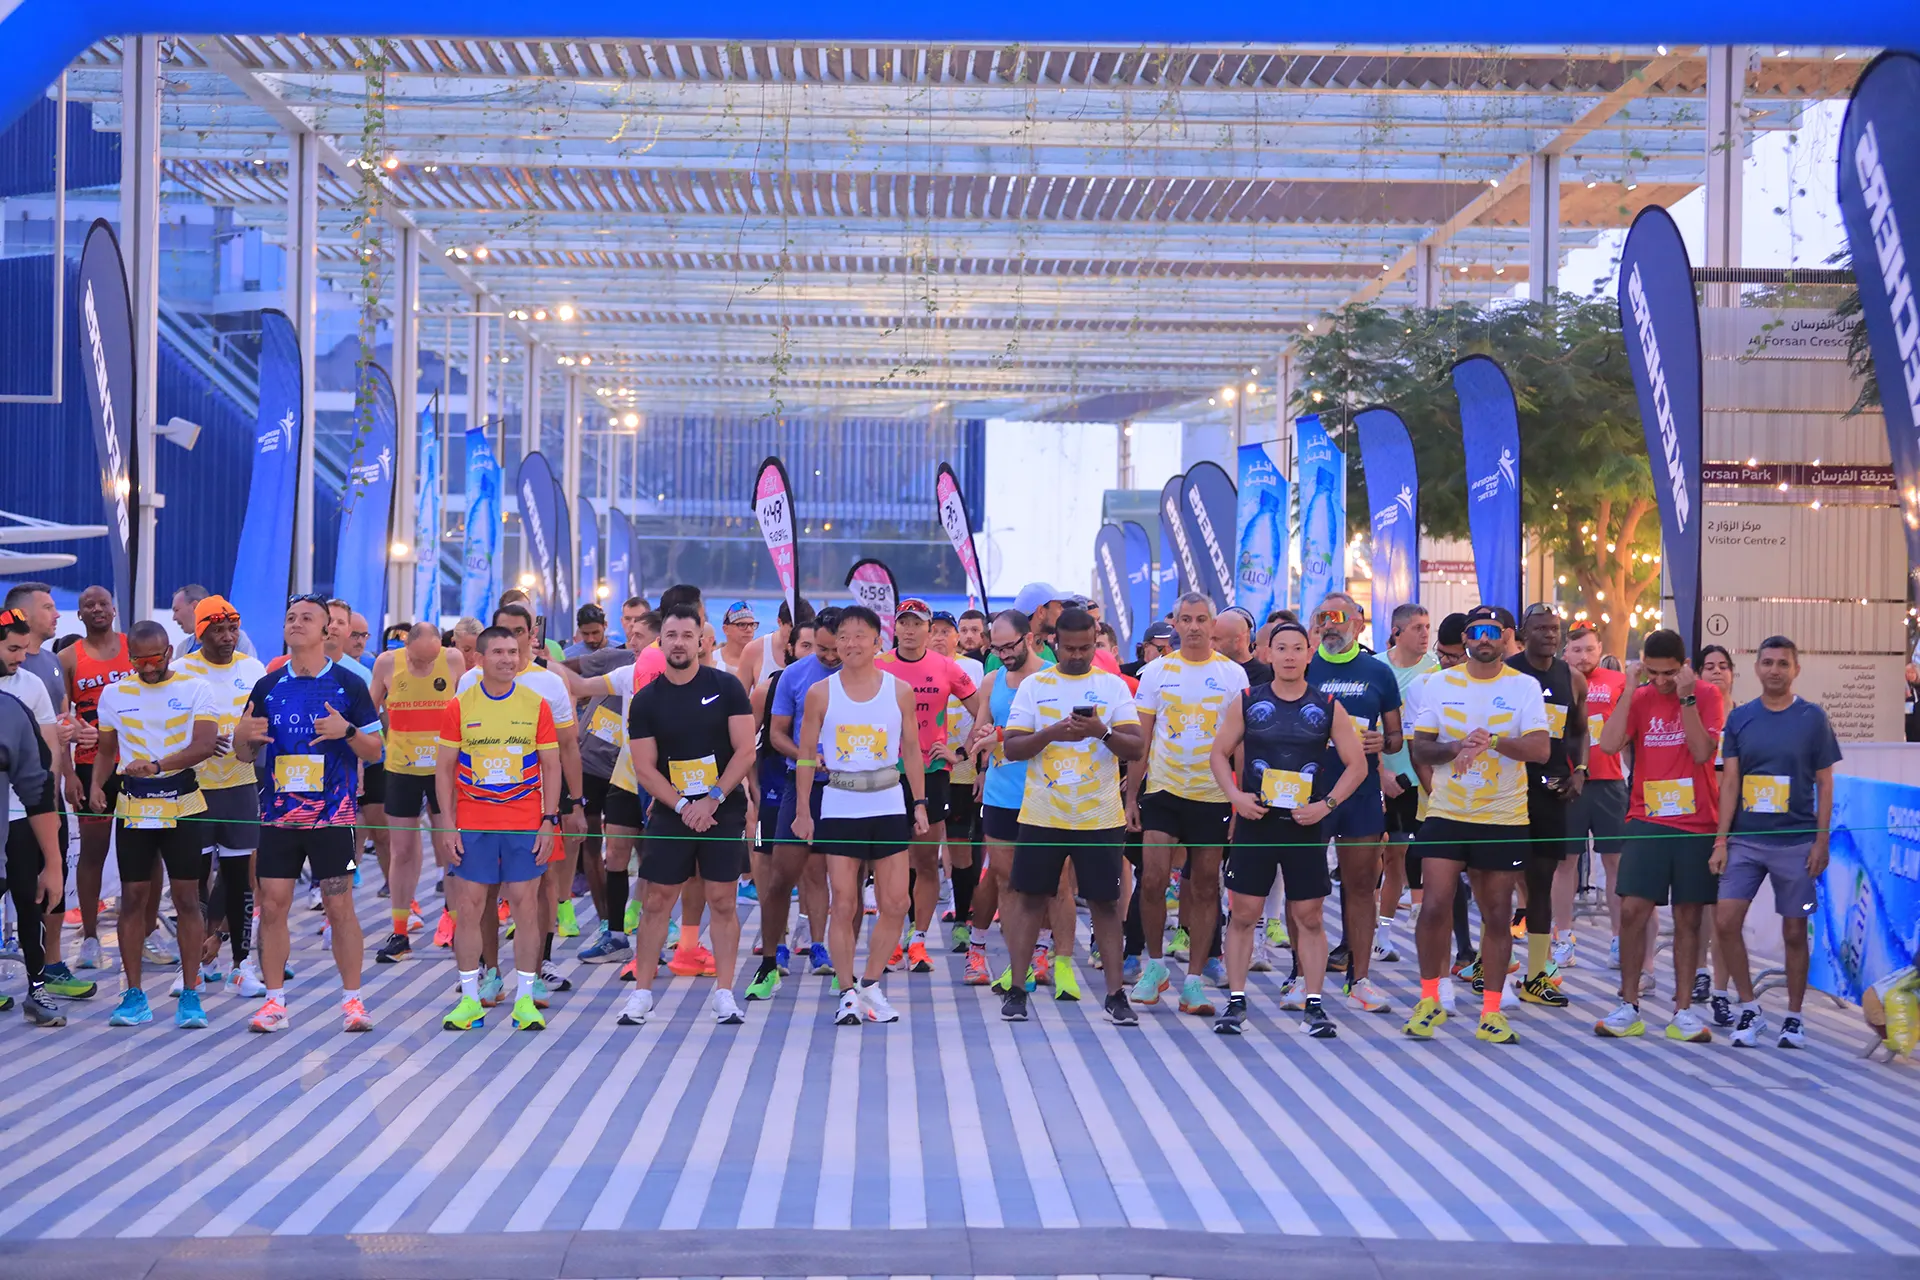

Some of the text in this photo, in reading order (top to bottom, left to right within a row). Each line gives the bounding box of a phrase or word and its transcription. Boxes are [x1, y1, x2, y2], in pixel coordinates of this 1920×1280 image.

[1791, 319, 1835, 333] الفرسان
[1764, 336, 1807, 346] Forsan
[1809, 336, 1852, 347] Cresce
[1702, 469, 1771, 480] orsan Park
[1811, 470, 1858, 483] الفرسان
[1708, 521, 1714, 530] 2
[1740, 520, 1762, 532] مركز
[1707, 535, 1787, 546] Visitor Centre 2
[860, 586, 886, 601] 1:59
[77, 674, 104, 692] Fat
[1320, 681, 1365, 693] RUNNING
[913, 686, 940, 694] AKER
[412, 699, 451, 708] DERBYSH
[273, 714, 319, 725] ROV
[847, 734, 876, 747] 002
[1643, 732, 1687, 741] SKECHE
[1643, 739, 1685, 747] PERFORMANC
[414, 745, 437, 756] 078
[483, 757, 512, 770] 003
[1053, 756, 1079, 771] 007
[1471, 760, 1489, 771] 90
[285, 765, 311, 777] 012
[681, 768, 706, 782] 139
[832, 778, 855, 788] aked
[1274, 780, 1301, 794] 036
[1655, 790, 1681, 802] 146
[1753, 786, 1775, 798] 143
[140, 804, 164, 817] 122
[1887, 804, 1920, 843] CHOOS
